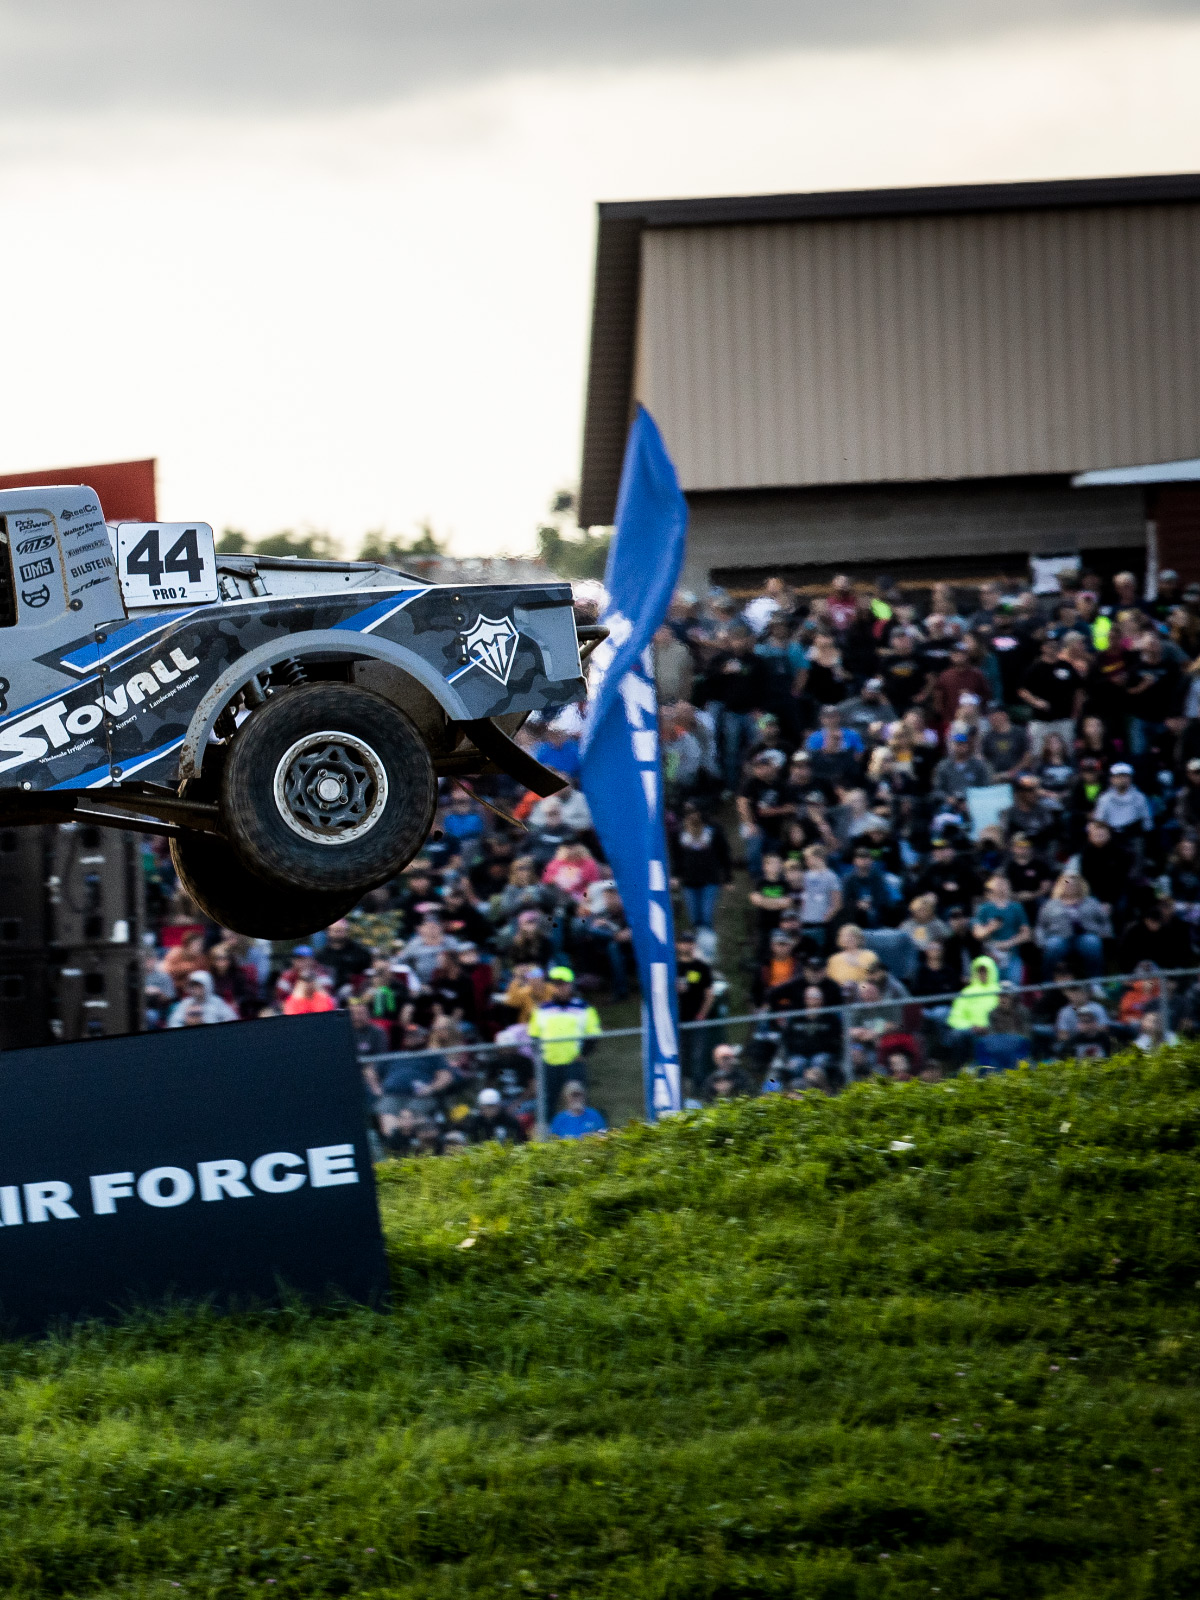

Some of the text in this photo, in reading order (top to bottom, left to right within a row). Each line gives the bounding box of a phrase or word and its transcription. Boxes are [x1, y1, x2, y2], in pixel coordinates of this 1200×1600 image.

[15, 520, 34, 528] Pro
[18, 535, 53, 555] MTS
[70, 556, 113, 578] BILSTEIN
[127, 529, 205, 587] 44
[152, 587, 188, 601] PRO 2
[66, 738, 95, 755] Irrigation
[115, 714, 138, 731] Nursery
[148, 688, 178, 709] Landscape
[175, 674, 200, 692] Supplies
[89, 1143, 360, 1216] FORCE
